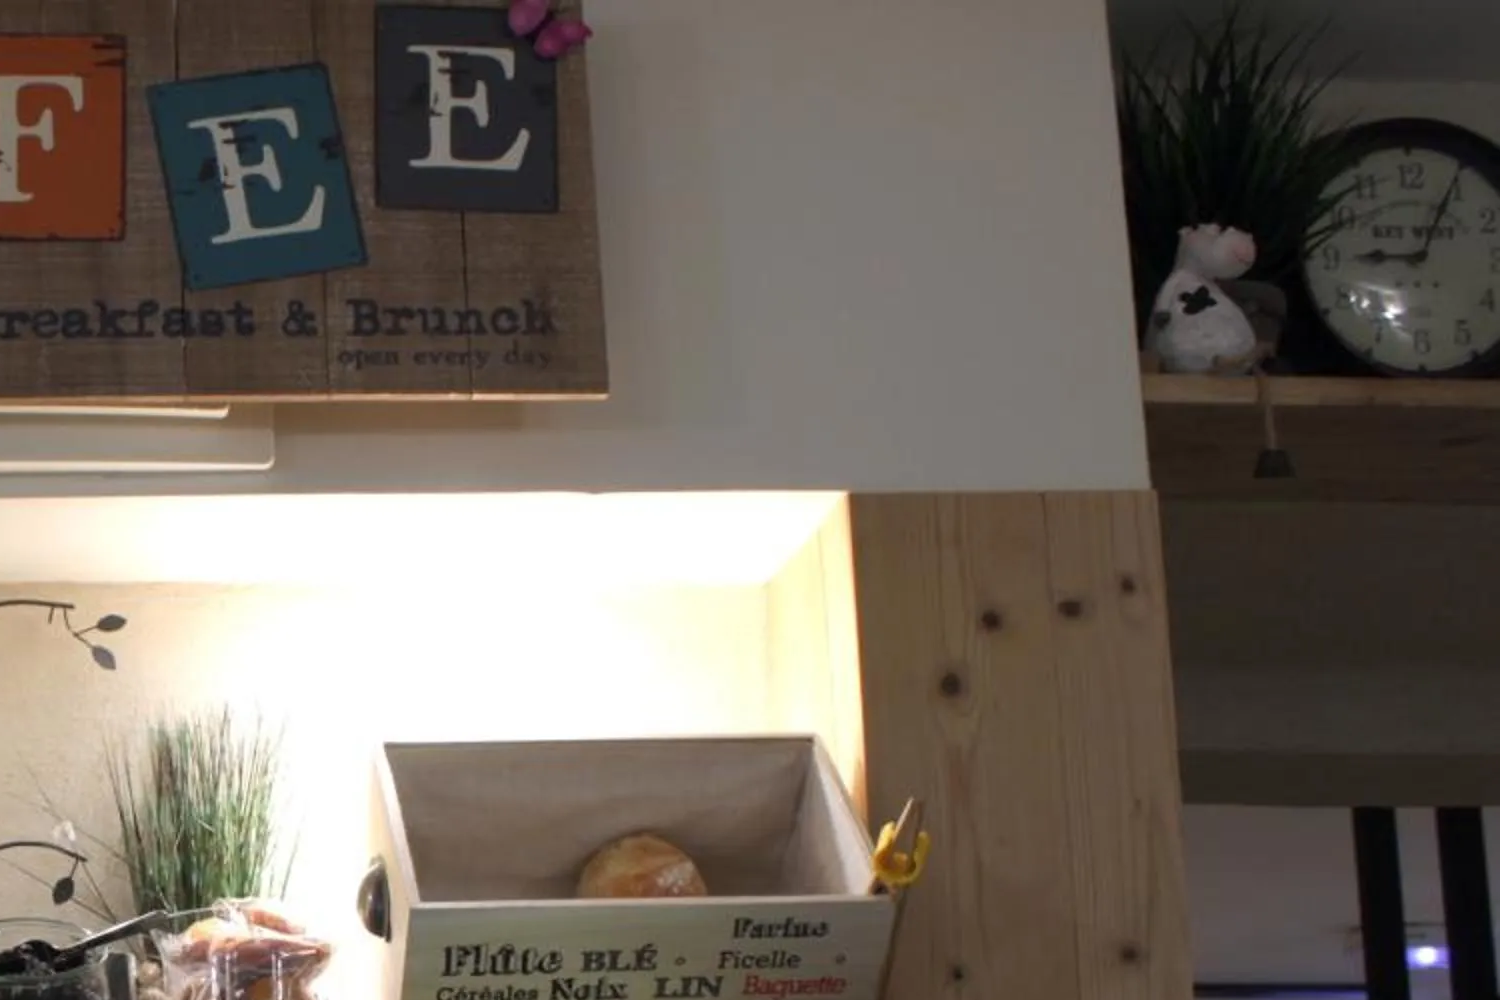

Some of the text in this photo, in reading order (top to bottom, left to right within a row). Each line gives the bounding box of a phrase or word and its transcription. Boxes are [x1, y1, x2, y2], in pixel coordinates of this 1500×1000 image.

[1397, 162, 1425, 190] 12
[1479, 208, 1497, 235] 2
[1321, 247, 1341, 271] 9
[1478, 287, 1495, 312] 4
[281, 302, 318, 339] &
[346, 300, 558, 340] Brunch
[1453, 319, 1472, 345] 5
[1414, 328, 1431, 355] 6
[337, 343, 553, 369] open every day
[732, 917, 830, 940] Farine
[441, 943, 801, 978] Flûte BLÉ Ficelle
[653, 975, 723, 999] LIN
[741, 975, 847, 1000] Baguette
